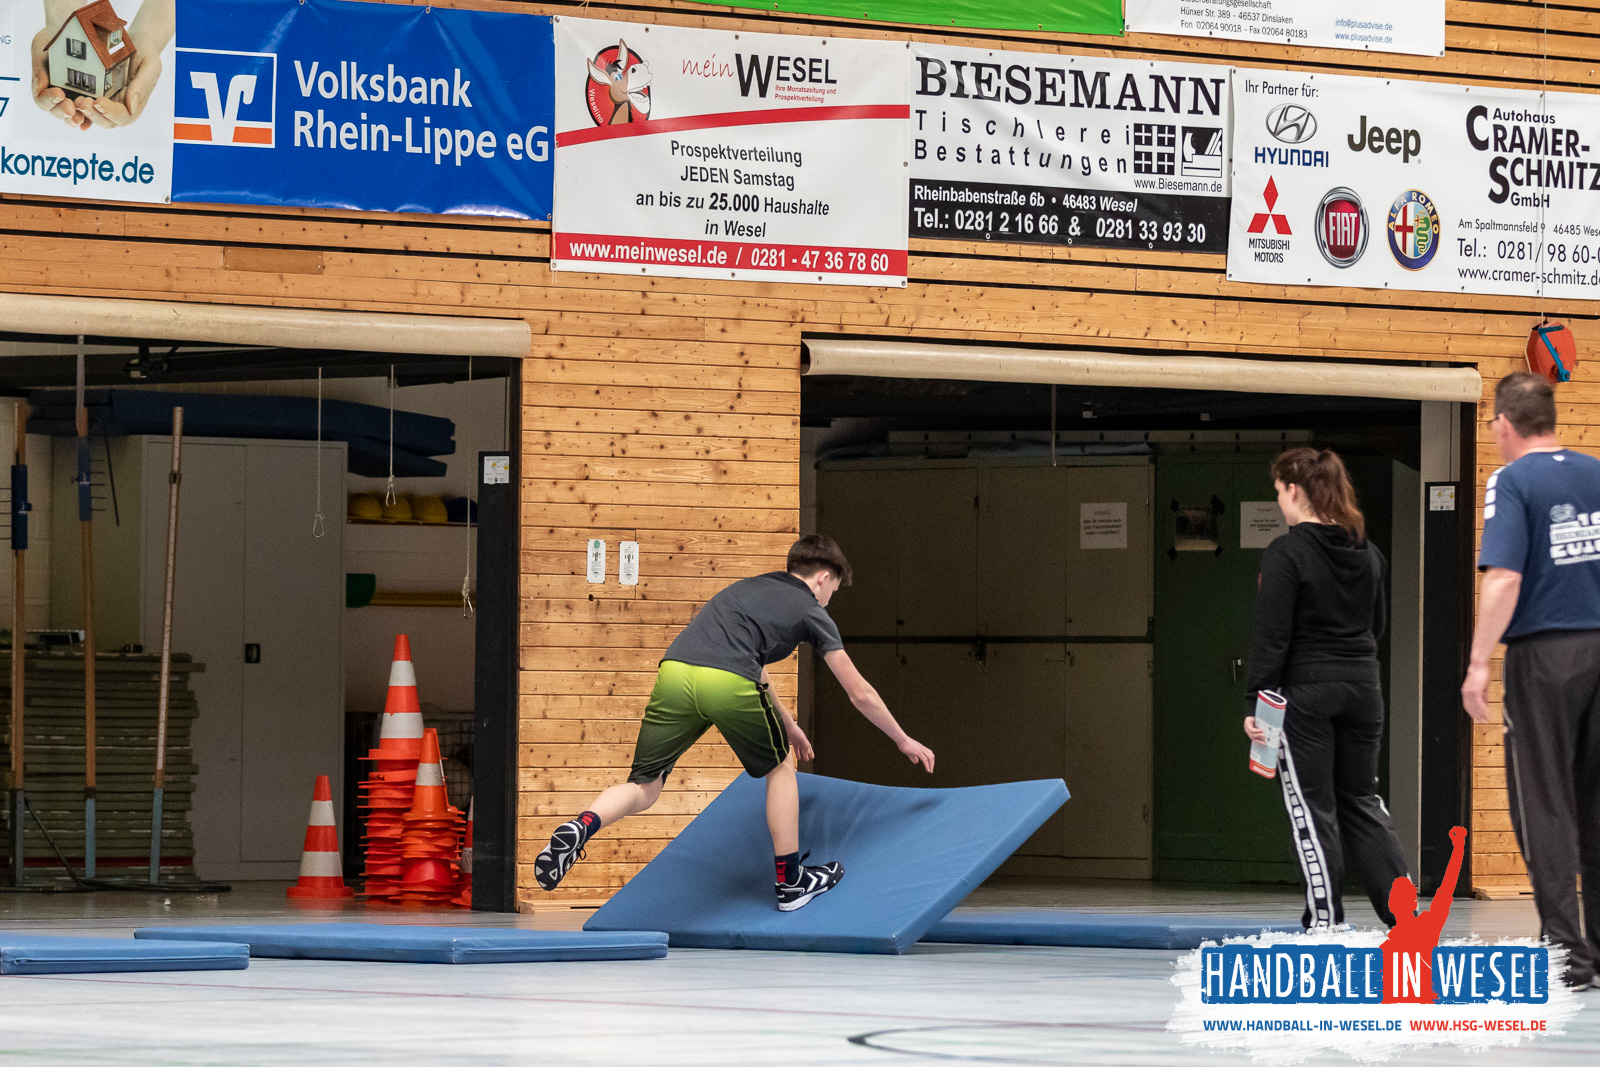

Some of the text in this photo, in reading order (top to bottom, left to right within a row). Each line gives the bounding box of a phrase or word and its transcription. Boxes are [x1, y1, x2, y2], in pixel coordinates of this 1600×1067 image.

[1180, 6, 1204, 17] Hünxer
[1205, 8, 1216, 18] Str.
[1218, 10, 1230, 18] 389
[1238, 12, 1260, 20] 46537
[1262, 14, 1294, 24] Dinslaken
[1335, 18, 1392, 30] info@plusadvise.de
[1180, 20, 1192, 28] Fon
[1196, 20, 1218, 30] 02064
[1220, 24, 1242, 32] 90018
[1250, 25, 1260, 34] Fax
[1262, 26, 1284, 36] 02064
[1286, 28, 1308, 38] 80183
[1335, 33, 1392, 43] www.plusadvise.de
[294, 60, 472, 107] Volksbank
[682, 53, 837, 98] mein WESEL
[916, 56, 1225, 116] BIESEMANN
[774, 93, 824, 104] Prospektverteilung
[787, 86, 826, 95] Monatszeitung
[1246, 80, 1318, 98] Ihr Partner für:
[589, 89, 604, 122] Weselino
[1493, 108, 1556, 124] Autohaus
[294, 109, 549, 166] Rhein-Lippe eG
[915, 109, 1130, 146] Tischlerei
[1348, 115, 1421, 164] Jeep
[1466, 105, 1590, 158] CRAMER-
[1, 146, 154, 185] konzepte.de
[670, 140, 802, 167] Prospektverteilung
[914, 138, 1126, 176] Bestattungen
[1255, 146, 1328, 168] HYUNDAI
[680, 166, 795, 191] JEDEN Samstag
[1134, 178, 1222, 193] www.Biesemann.de
[1488, 156, 1600, 204] SCHMITZ
[636, 191, 830, 216] an bis zu 25.000 Haushalte
[914, 184, 1138, 212] Rheinbabenstraße 6b 46483 Wesel
[1511, 192, 1550, 208] GmbH
[914, 207, 1206, 243] Tel.: 0281 2 16 66 & 0281 33 93 30
[1388, 192, 1439, 234] ALFA ROMEO
[705, 219, 766, 238] in Wesel
[1328, 212, 1358, 246] FIAT
[1458, 218, 1472, 228] Am
[1475, 218, 1538, 232] Spaltmannsfeld
[1553, 224, 1580, 236] 46485
[1583, 225, 1600, 236] Wes
[570, 241, 728, 265] www.meinwesel.de
[750, 248, 786, 268] 0281
[801, 250, 820, 269] 47
[824, 251, 843, 270] 36
[848, 252, 866, 271] 78
[870, 253, 888, 272] 60
[1248, 238, 1290, 250] MITSUBISHI
[1457, 238, 1486, 258] Tel.:
[1498, 240, 1542, 262] 0281/
[1548, 244, 1566, 262] 98
[1254, 252, 1284, 263] MOTORS
[1458, 267, 1600, 286] www.cramer-schmitz.d
